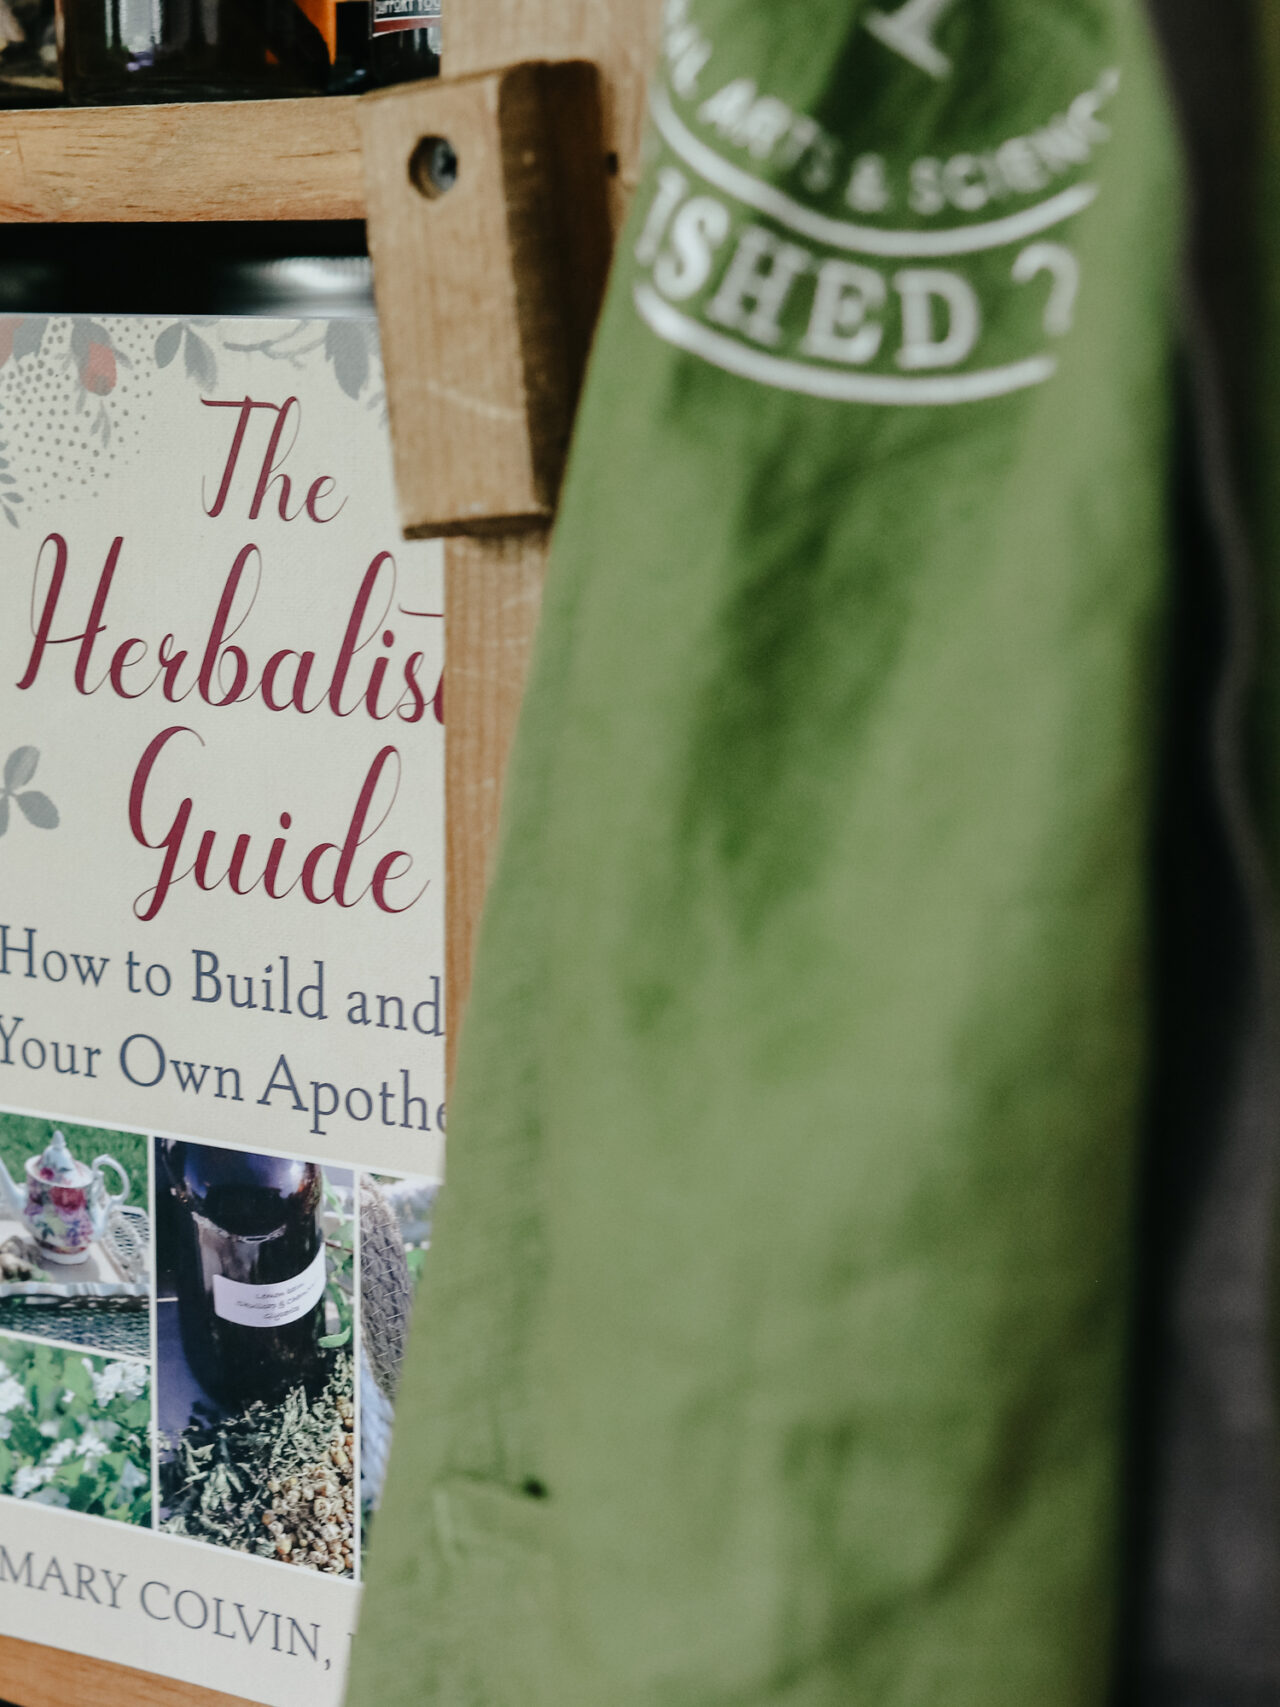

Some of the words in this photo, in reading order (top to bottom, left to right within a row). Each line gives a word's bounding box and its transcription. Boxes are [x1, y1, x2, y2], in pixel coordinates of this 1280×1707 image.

[200, 394, 350, 525] The
[127, 725, 431, 922] Guide
[125, 951, 173, 998] to
[191, 948, 330, 1021] Build
[346, 975, 446, 1037] and
[118, 1032, 245, 1103] Own
[139, 1580, 333, 1671] COLVIN,
